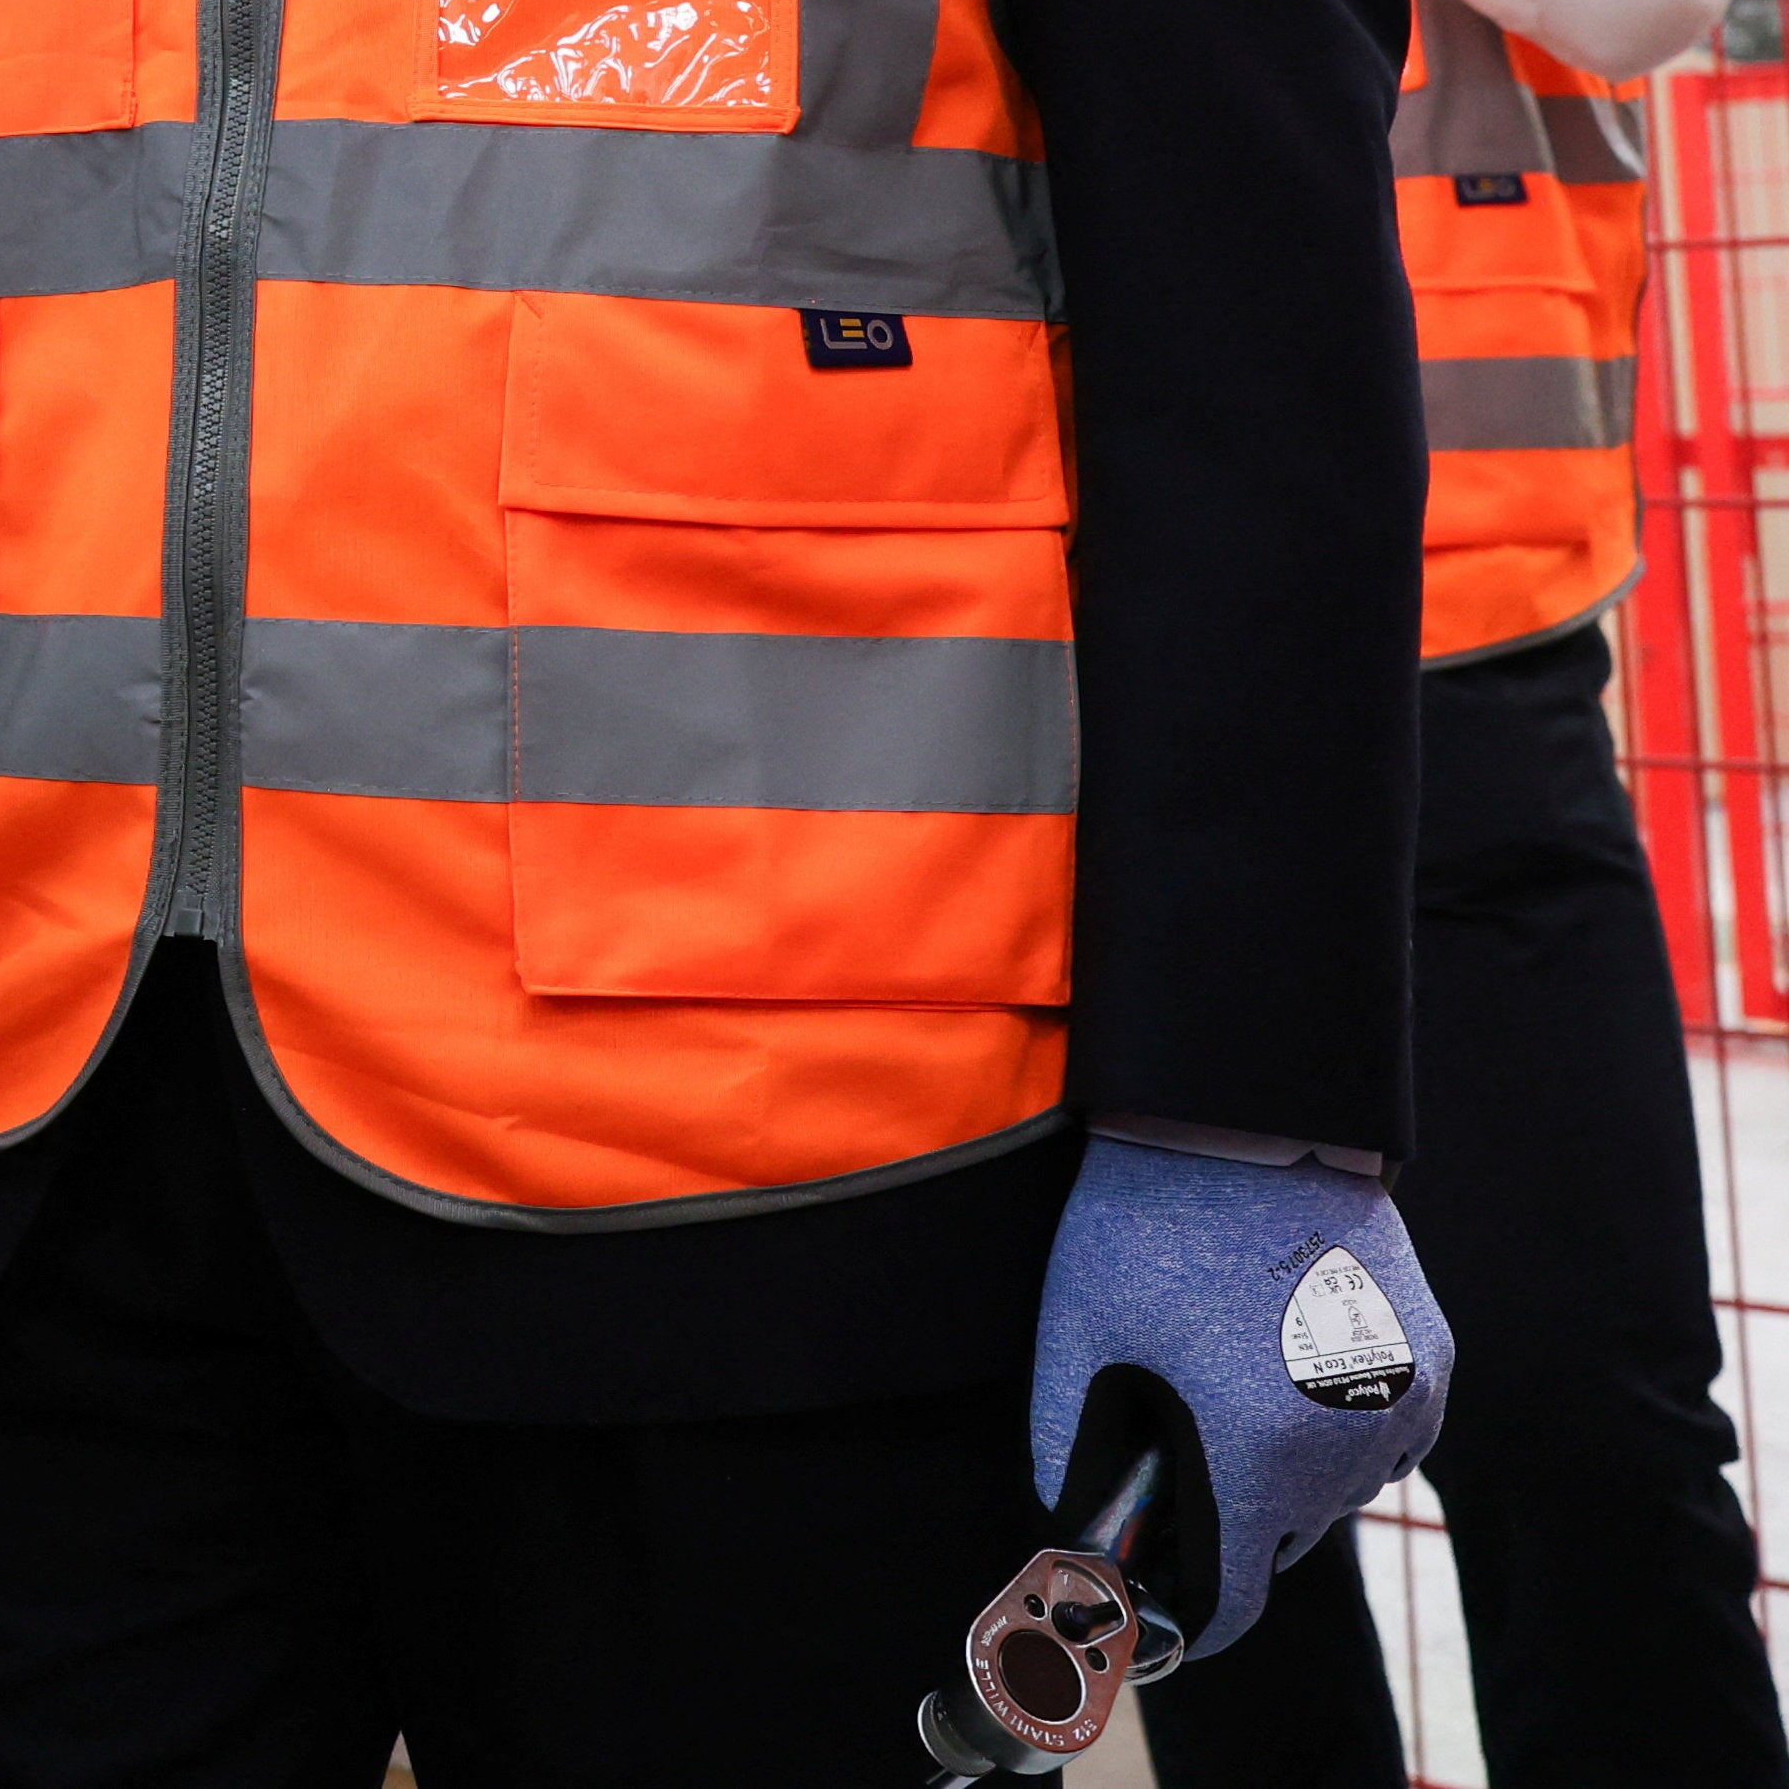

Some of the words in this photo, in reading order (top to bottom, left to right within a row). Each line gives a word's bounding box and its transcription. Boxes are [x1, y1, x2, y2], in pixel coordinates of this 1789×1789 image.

[819, 318, 894, 350] LEO
[1313, 1362, 1324, 1374] N
[1325, 1358, 1347, 1370] Eco
[1348, 1384, 1380, 1397] Polyco
